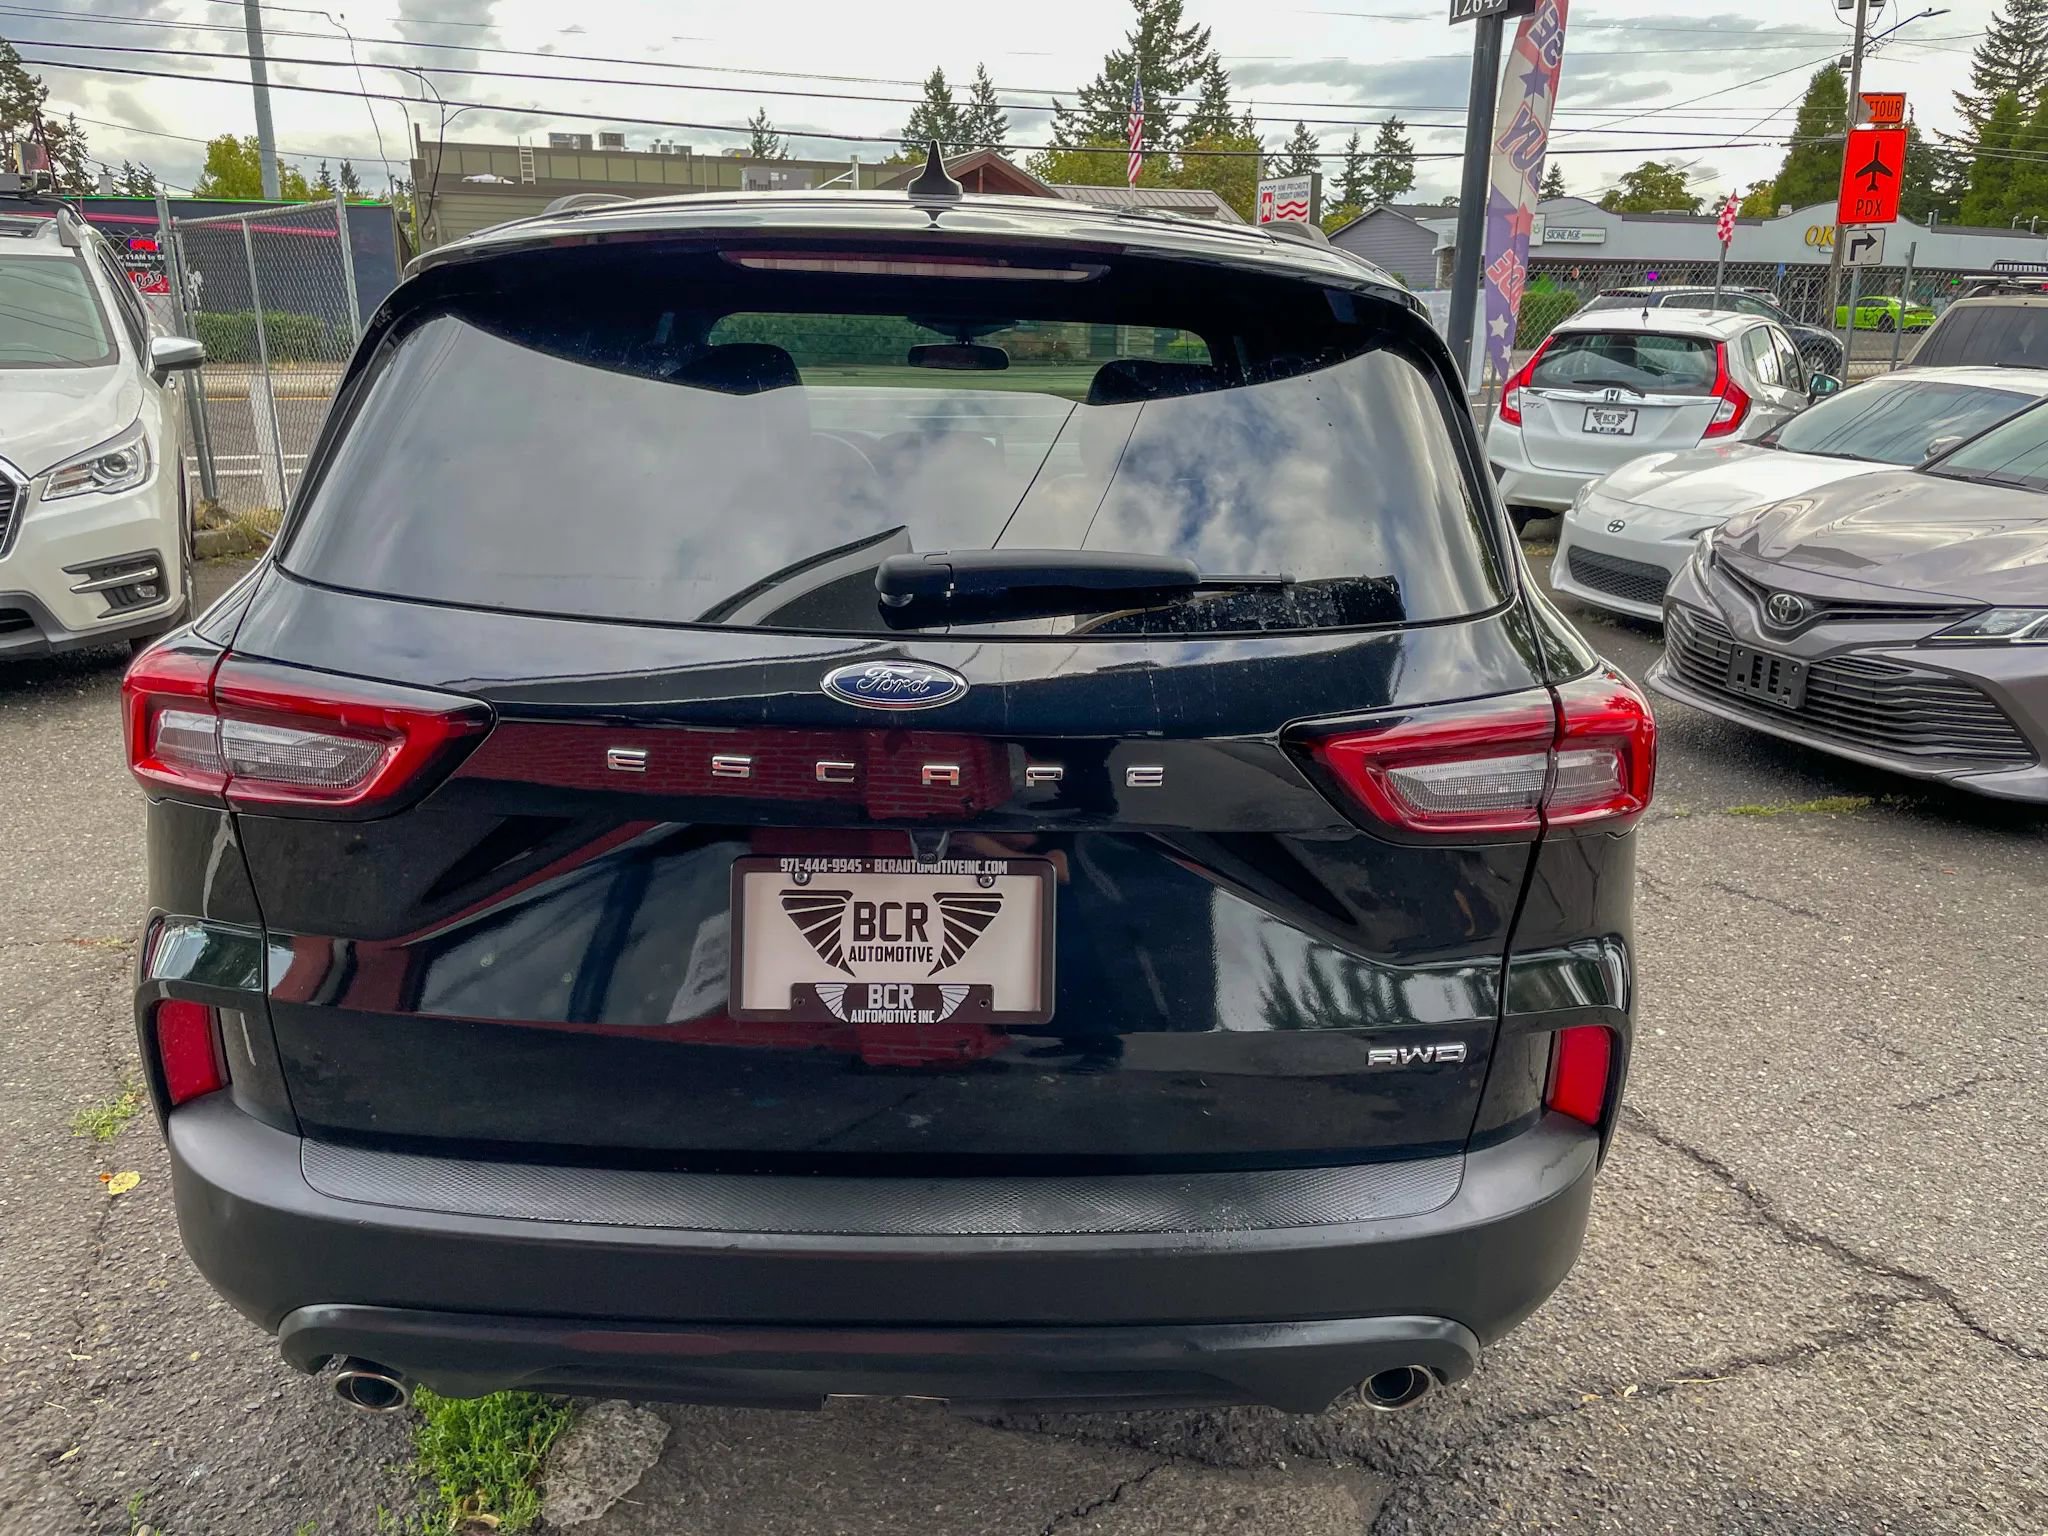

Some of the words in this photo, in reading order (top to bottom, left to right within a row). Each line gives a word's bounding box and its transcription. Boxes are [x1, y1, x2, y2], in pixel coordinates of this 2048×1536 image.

[1855, 199, 1883, 217] PDX
[856, 667, 931, 694] Ford
[606, 748, 1165, 787] ESCAPE
[780, 857, 862, 873] 971-444-9945
[874, 858, 1008, 874] BCRAUTOMOTIVEINC.COM
[853, 901, 929, 943] BCR
[848, 946, 933, 963] AUTOMOTIVE
[867, 984, 914, 1009] BCR
[850, 1009, 917, 1024] AUTOMOTIVE
[918, 1009, 935, 1024] INC
[1367, 1042, 1467, 1066] AWD
